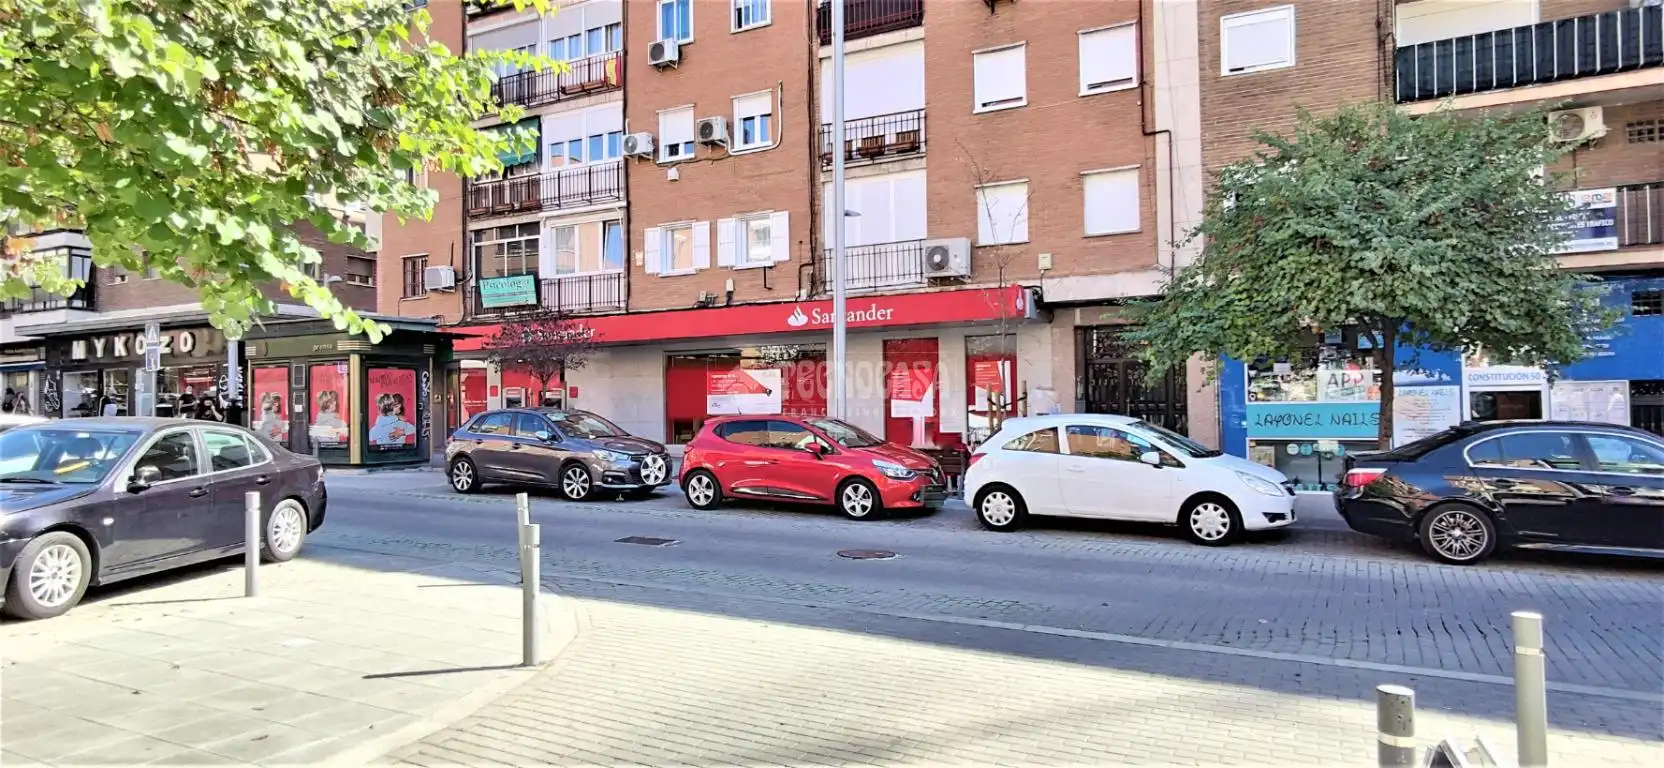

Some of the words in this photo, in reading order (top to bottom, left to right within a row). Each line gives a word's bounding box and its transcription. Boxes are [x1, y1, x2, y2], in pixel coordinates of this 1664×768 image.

[811, 304, 893, 325] Saander
[71, 331, 194, 360] MYKOZO
[1330, 412, 1380, 426] NAILS
